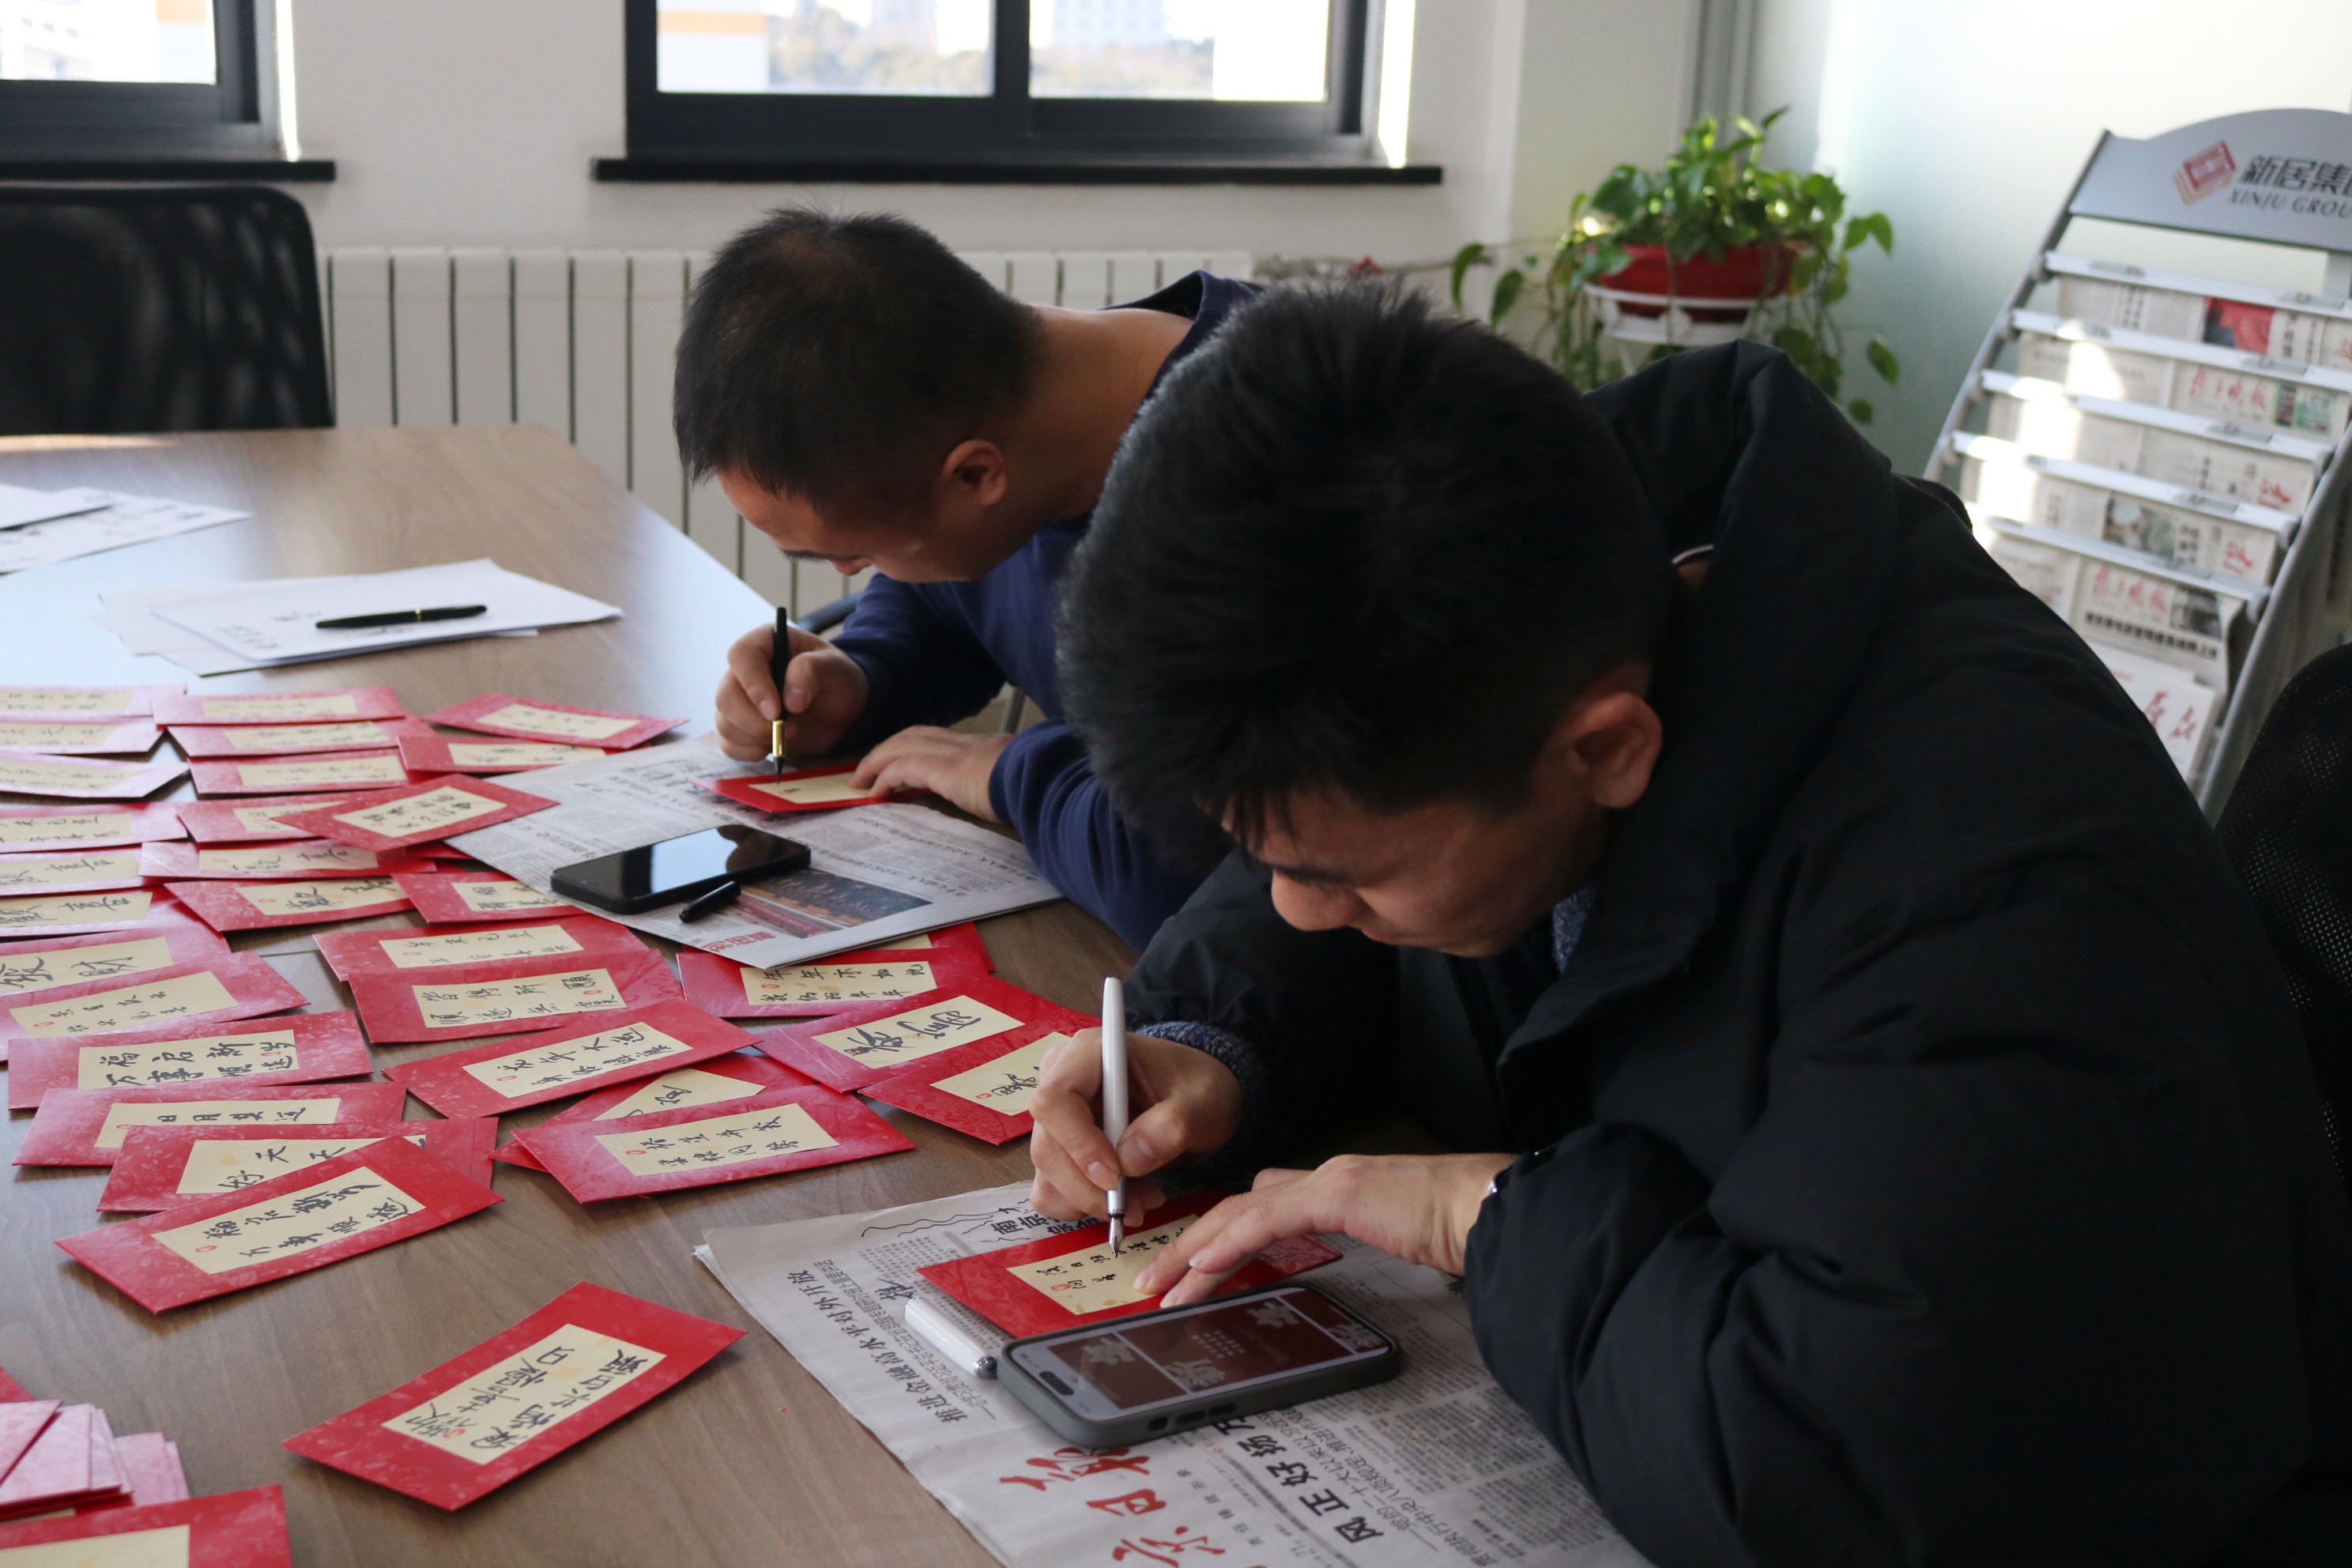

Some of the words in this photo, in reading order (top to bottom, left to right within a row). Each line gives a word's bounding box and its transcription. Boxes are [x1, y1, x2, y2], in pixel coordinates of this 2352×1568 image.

[2237, 154, 2352, 198] 新居集
[2230, 188, 2288, 210] XINJU
[786, 1268, 969, 1423] 推进金融高水平对外开放
